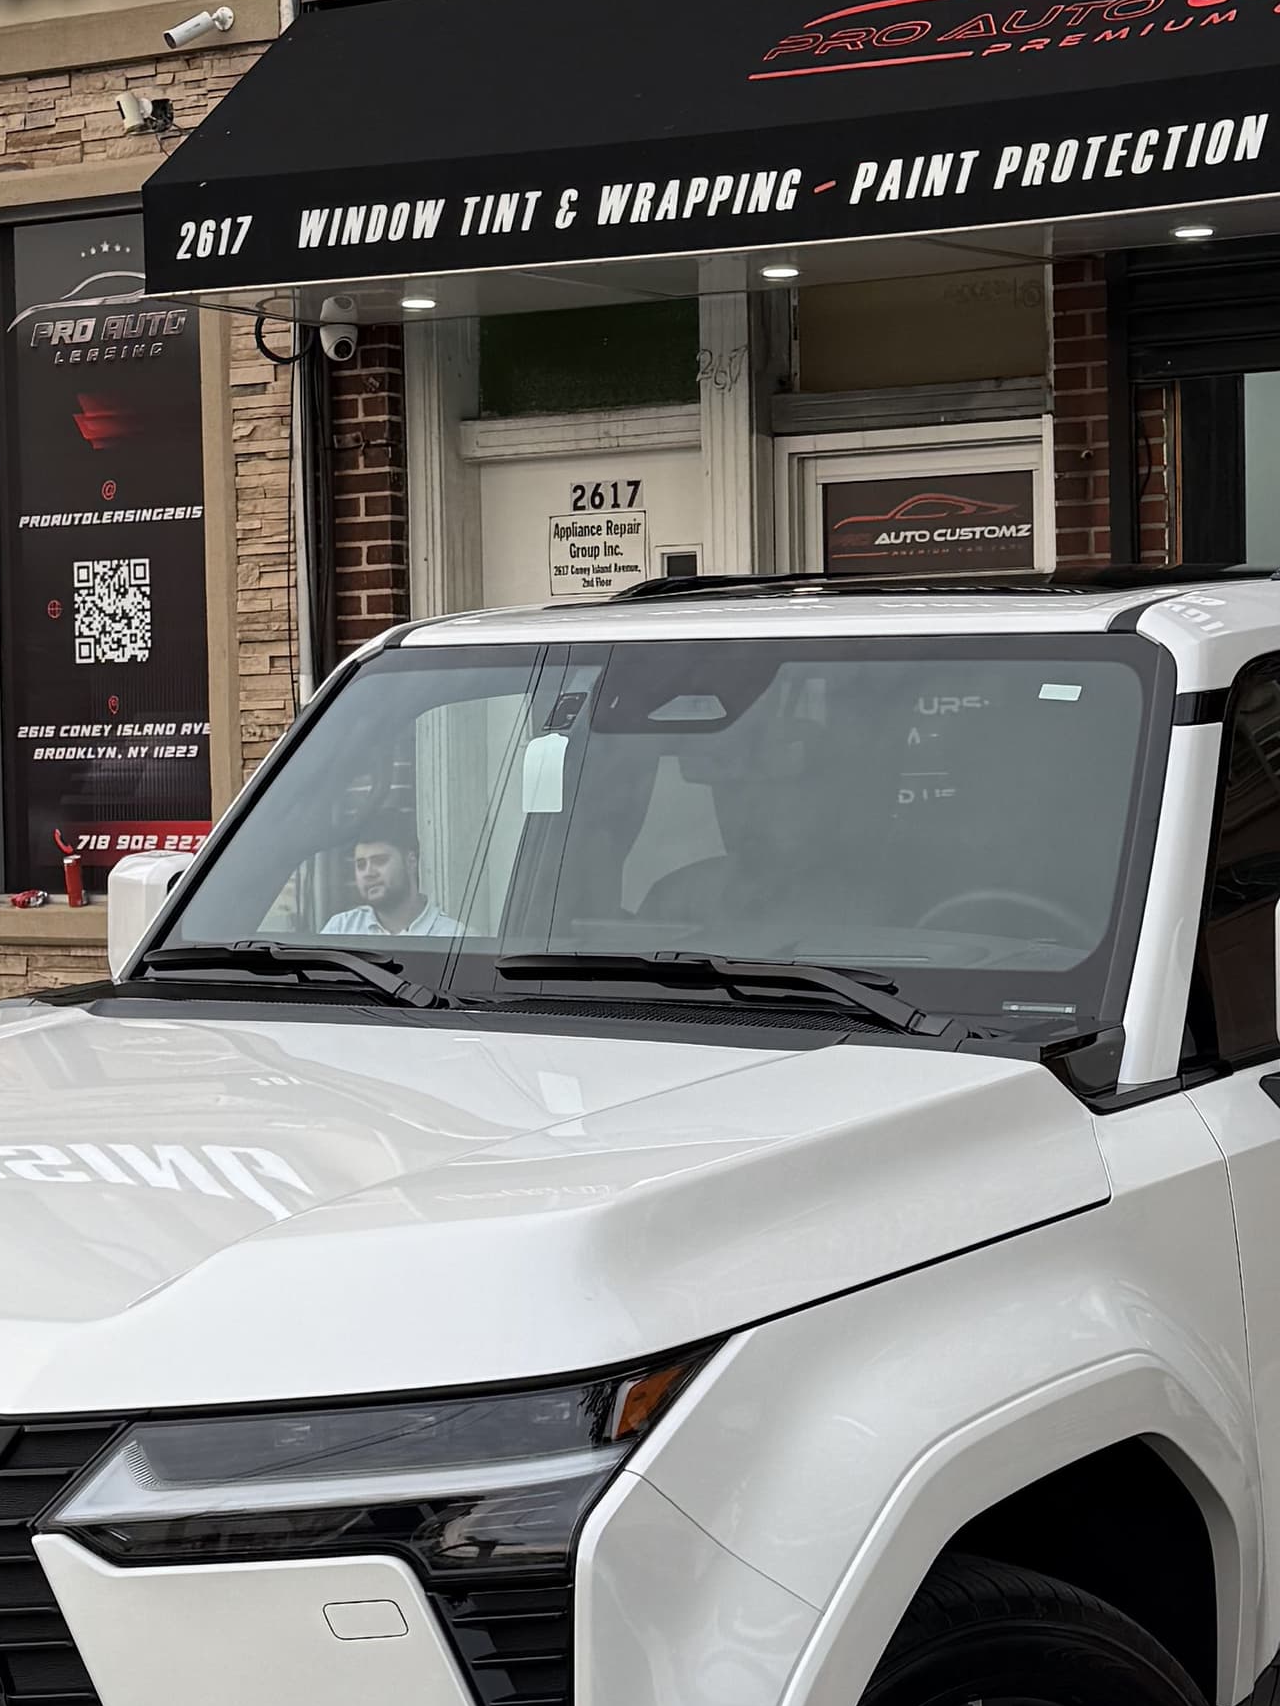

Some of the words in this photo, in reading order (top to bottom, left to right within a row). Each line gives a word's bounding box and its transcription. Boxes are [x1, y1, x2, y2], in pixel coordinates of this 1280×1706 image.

[763, 21, 931, 61] PRO
[982, 9, 1237, 56] PREMIUM
[176, 216, 252, 260] 2617
[298, 199, 444, 249] WINDOW
[460, 191, 542, 237] TINT
[555, 188, 578, 230] &
[597, 168, 802, 225] WRAPPING
[849, 150, 980, 204] PAINT
[993, 113, 1268, 189] PROTECTION
[31, 317, 96, 347] PRO
[101, 309, 188, 342] AUTO
[54, 342, 164, 365] LEASING
[101, 480, 117, 500] @
[572, 479, 642, 511] 2617
[19, 505, 203, 528] PROAUTOLEASING2615
[553, 522, 602, 541] Appliance
[606, 518, 642, 536] Repair
[874, 530, 930, 546] AUTO
[933, 523, 1032, 542] CUSTOMZ
[569, 543, 600, 560] Group
[604, 541, 624, 557] Inc.
[17, 725, 55, 739] 2615
[59, 724, 113, 738] CONEY
[116, 723, 176, 736] ISLAND
[127, 745, 150, 759] NY
[153, 745, 199, 758] 11223
[76, 835, 110, 850] 718
[117, 835, 158, 850] 902
